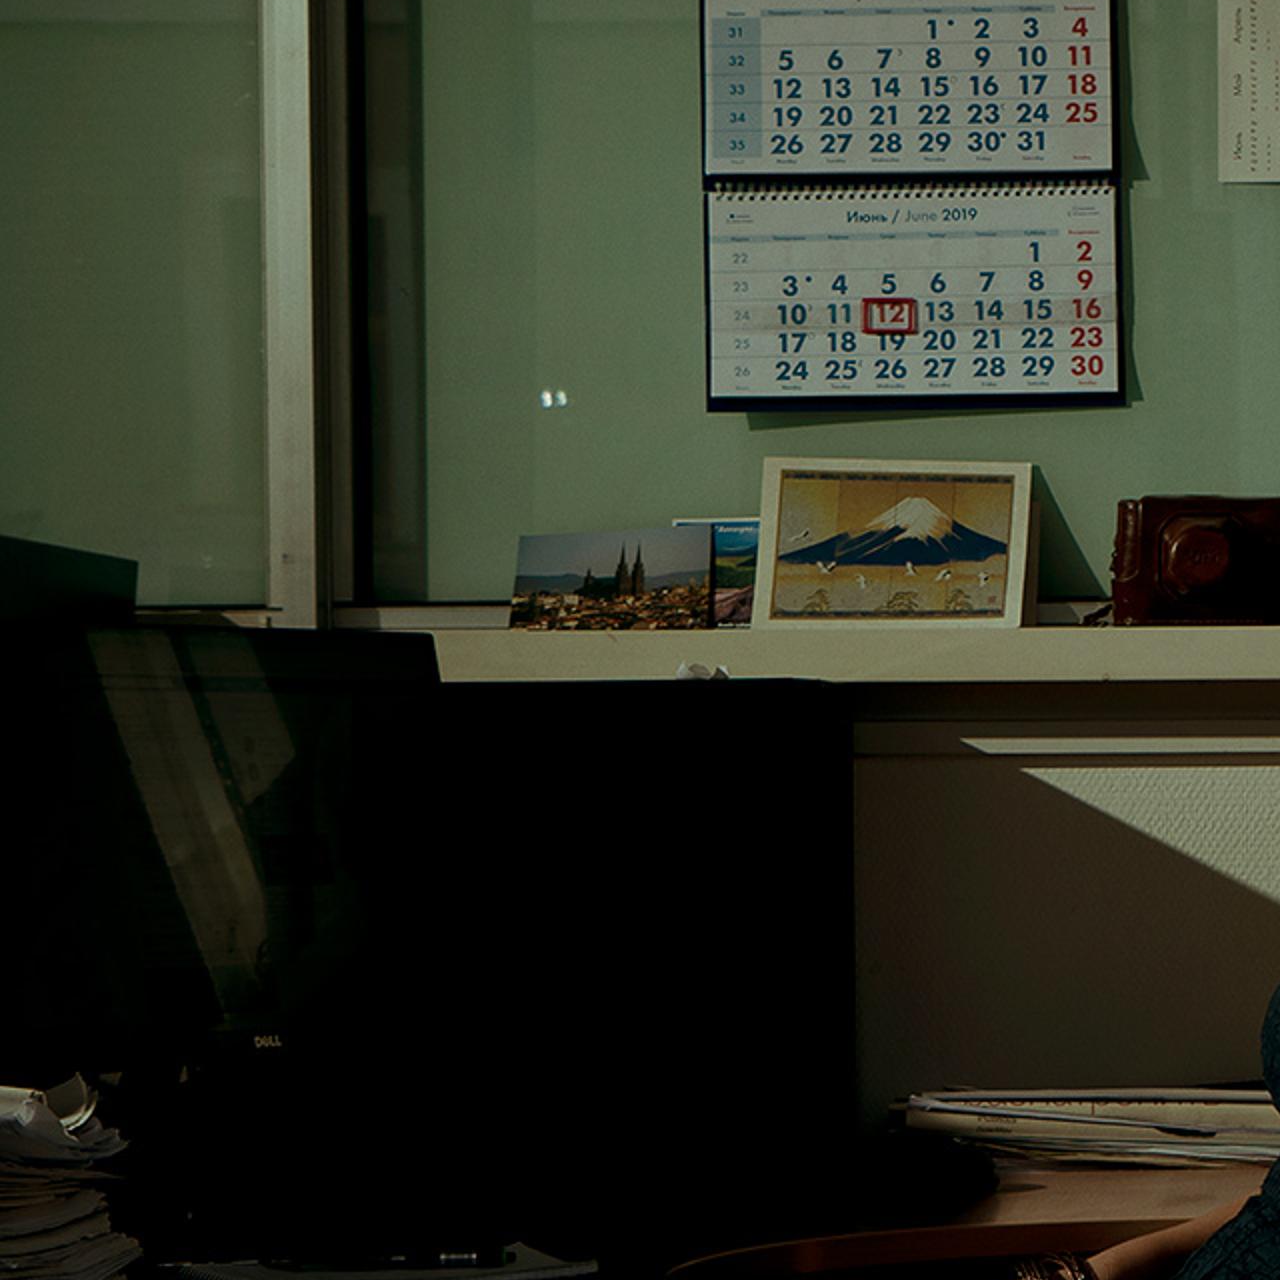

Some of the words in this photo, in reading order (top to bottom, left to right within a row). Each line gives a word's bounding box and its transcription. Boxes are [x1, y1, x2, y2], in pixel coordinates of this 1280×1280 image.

[729, 27, 744, 38] 31
[927, 19, 937, 40] 1
[974, 18, 990, 39] 2
[1023, 17, 1039, 39] 3
[1071, 17, 1088, 37] 4
[728, 55, 745, 66] 32
[779, 49, 794, 71] 5
[827, 49, 843, 71] 6
[877, 48, 893, 69] 7
[926, 47, 941, 69] 8
[975, 46, 991, 67] 9
[1019, 45, 1047, 67] 10
[1067, 45, 1091, 66] 11
[729, 84, 745, 95] 33
[773, 78, 801, 99] 12
[823, 77, 851, 99] 13
[872, 77, 901, 97] 14
[921, 76, 949, 97] 15
[970, 75, 999, 97] 16
[1019, 75, 1047, 95] 17
[1068, 73, 1097, 95] 18
[729, 112, 746, 123] 34
[774, 106, 802, 127] 19
[820, 106, 853, 127] 20
[870, 105, 897, 125] 21
[918, 103, 950, 125] 22
[967, 103, 1000, 124] 23
[1017, 103, 1049, 123] 24
[1065, 102, 1098, 123] 25
[729, 140, 745, 151] 35
[771, 135, 803, 155] 26
[821, 133, 853, 153] 27
[869, 132, 902, 153] 28
[919, 132, 951, 152] 29
[967, 131, 1001, 152] 30
[1017, 131, 1044, 151] 31
[847, 210, 888, 224] Июнь
[904, 208, 938, 222] June
[942, 207, 978, 221] 2019
[1029, 241, 1039, 263] 1
[1077, 240, 1092, 262] 2
[783, 275, 798, 297] 3
[831, 274, 848, 295] 4
[881, 273, 897, 295] 5
[930, 272, 947, 294] 6
[979, 271, 995, 292] 7
[1029, 270, 1044, 291] 8
[1077, 269, 1093, 290] 9
[777, 303, 807, 325] 10
[827, 303, 851, 324] 11
[877, 300, 906, 324] 12
[925, 301, 954, 322] 13
[975, 300, 1003, 321] 14
[1023, 299, 1052, 320] 15
[1072, 298, 1102, 319] 16
[778, 332, 807, 353] 17
[827, 331, 857, 353] 18
[878, 332, 906, 351] 19
[923, 329, 956, 351] 20
[973, 329, 1000, 349] 21
[1021, 327, 1053, 348] 22
[1070, 327, 1103, 348] 23
[775, 361, 809, 381] 24
[825, 359, 857, 380] 25
[875, 359, 907, 379] 26
[924, 358, 956, 378] 27
[973, 357, 1006, 377] 28
[1022, 355, 1055, 377] 29
[1071, 355, 1103, 376] 30
